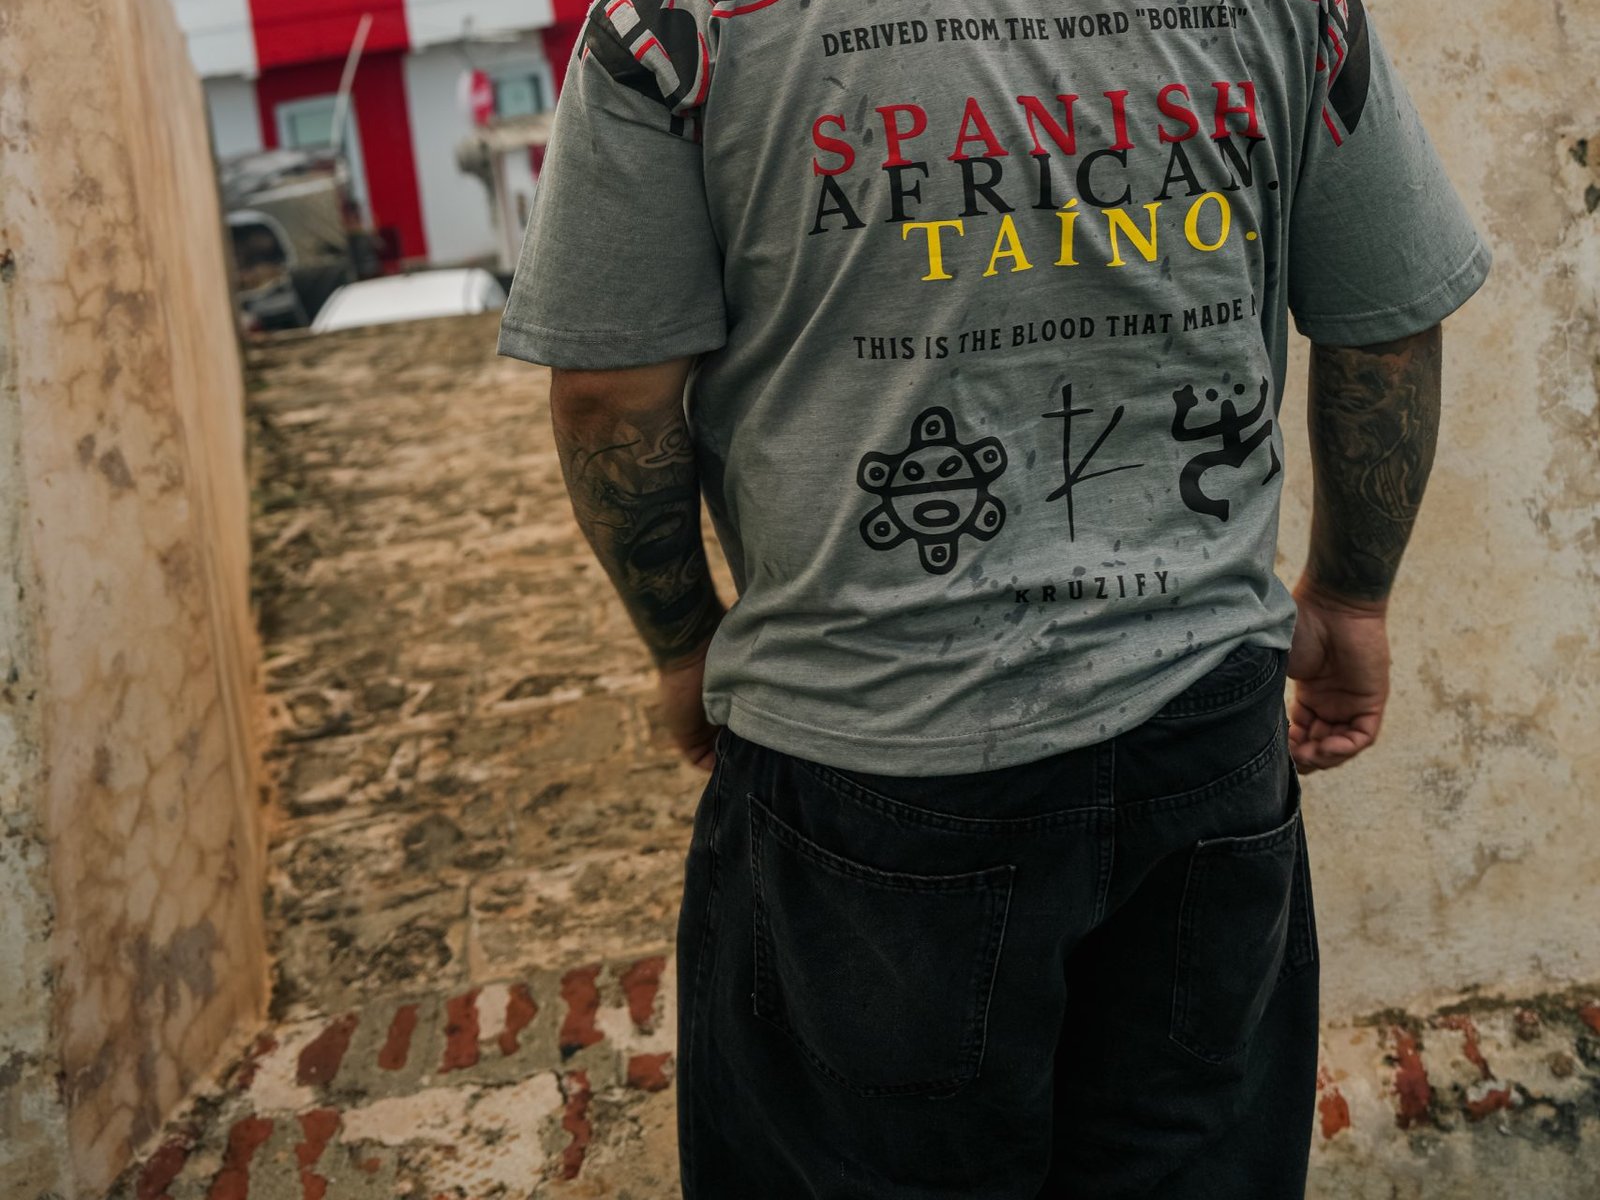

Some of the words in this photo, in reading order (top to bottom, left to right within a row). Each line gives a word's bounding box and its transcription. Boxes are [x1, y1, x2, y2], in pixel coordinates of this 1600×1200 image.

[822, 19, 928, 57] DERIVED
[936, 16, 1000, 42] FROM
[1005, 17, 1049, 40] THE
[1055, 10, 1130, 38] WORD
[811, 80, 1266, 177] SPANISH
[808, 136, 1279, 236] AFRICAN.
[902, 191, 1257, 281] TAÍNO.
[854, 336, 915, 360] THIS
[925, 336, 949, 359] IS
[958, 328, 1002, 354] THE
[1011, 316, 1096, 348] BLOOD
[1106, 313, 1173, 337] THAT
[1183, 298, 1244, 332] MADE
[1015, 570, 1170, 604] KRUZIFY
